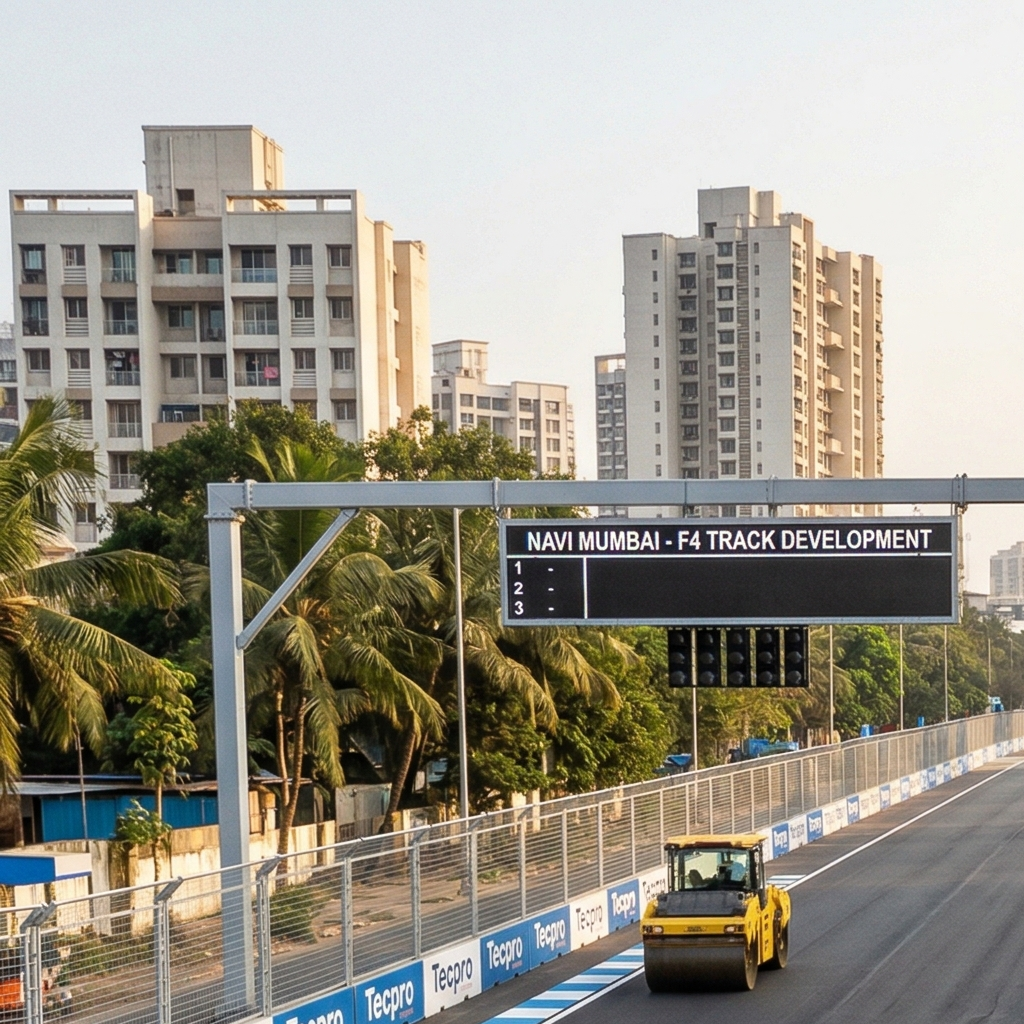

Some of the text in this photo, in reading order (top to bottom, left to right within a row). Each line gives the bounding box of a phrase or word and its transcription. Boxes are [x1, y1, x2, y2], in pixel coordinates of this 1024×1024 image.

[527, 531, 573, 551] NAVI
[579, 531, 660, 551] MUMBAI
[678, 530, 701, 551] F4
[706, 530, 775, 551] TRACK
[781, 529, 933, 550] DEVELOPMENT
[514, 561, 521, 575] 1
[513, 581, 523, 595] 2
[514, 601, 524, 615] 3
[575, 903, 603, 934] Tecpro
[534, 918, 566, 951] Tecpro
[487, 936, 523, 970] Tecpro
[431, 957, 473, 994] Tecpro
[364, 980, 414, 1021] Tecpro
